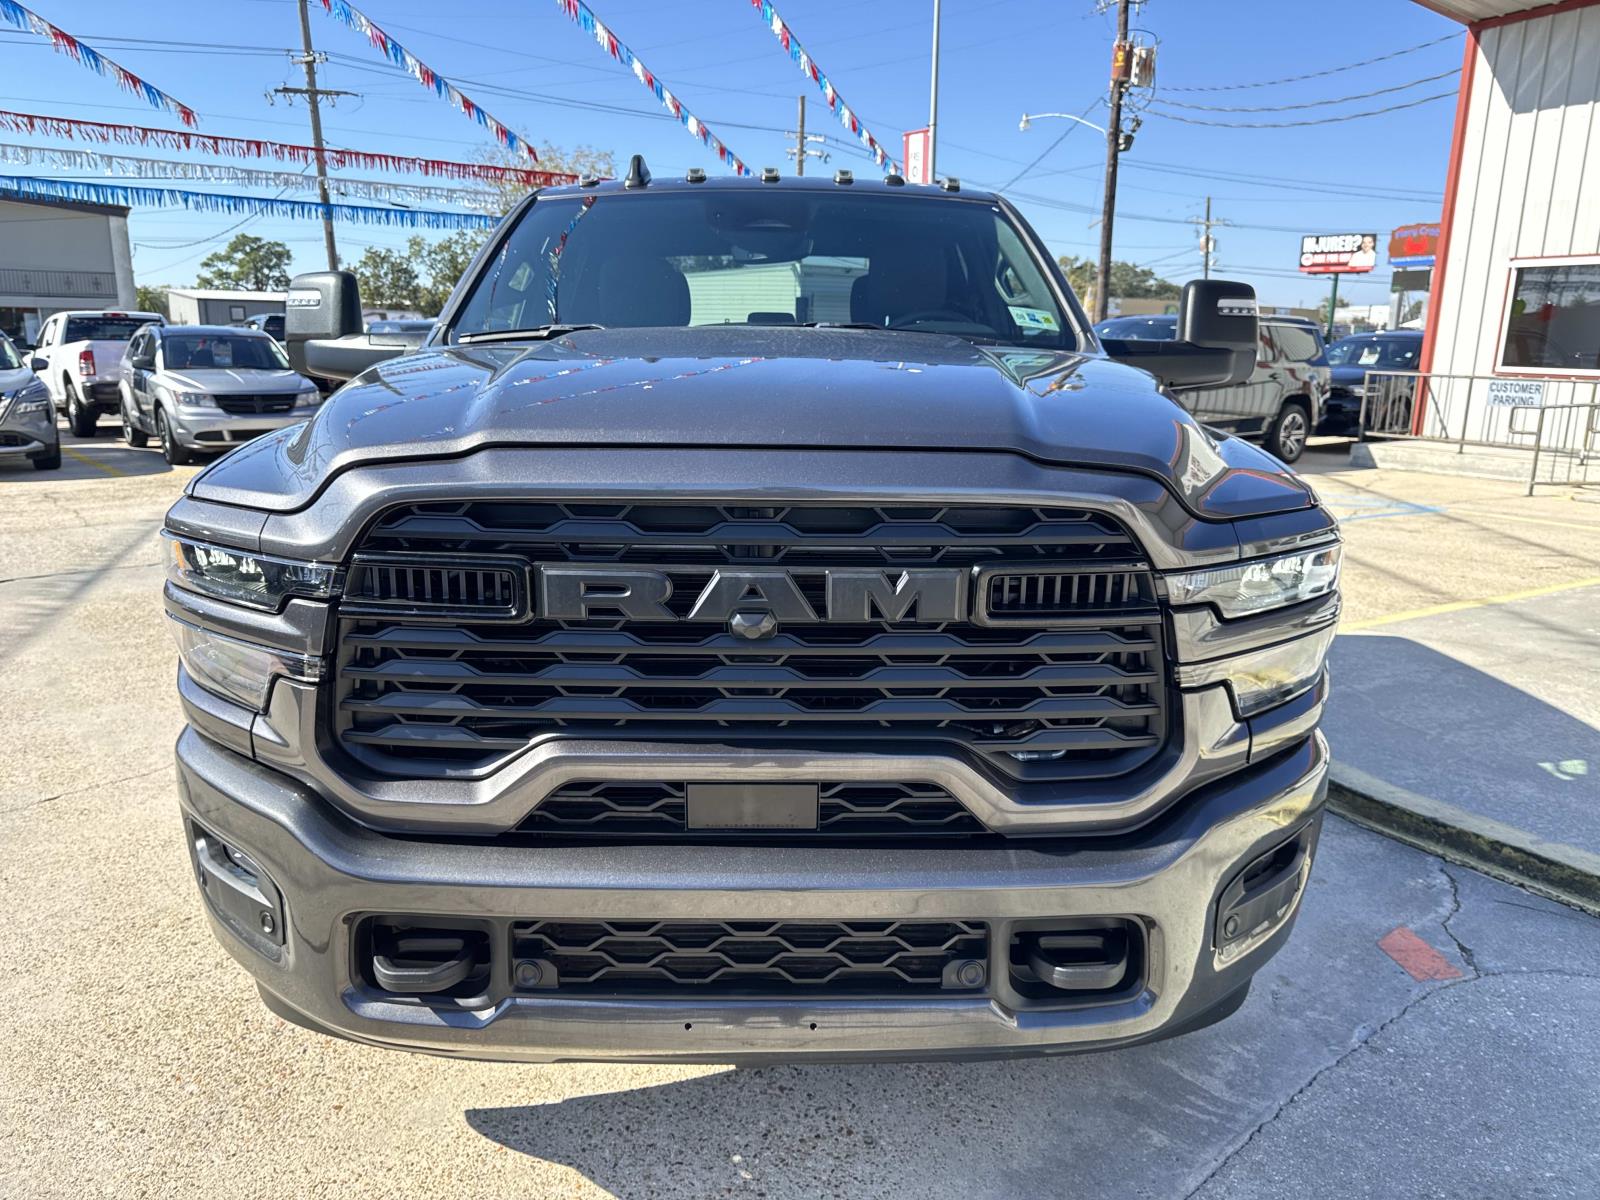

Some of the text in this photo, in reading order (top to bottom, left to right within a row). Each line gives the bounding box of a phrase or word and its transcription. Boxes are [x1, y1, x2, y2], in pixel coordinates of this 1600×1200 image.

[1489, 382, 1542, 394] CUSTOMER
[1493, 394, 1534, 405] PARKING
[540, 566, 966, 622] RAM
